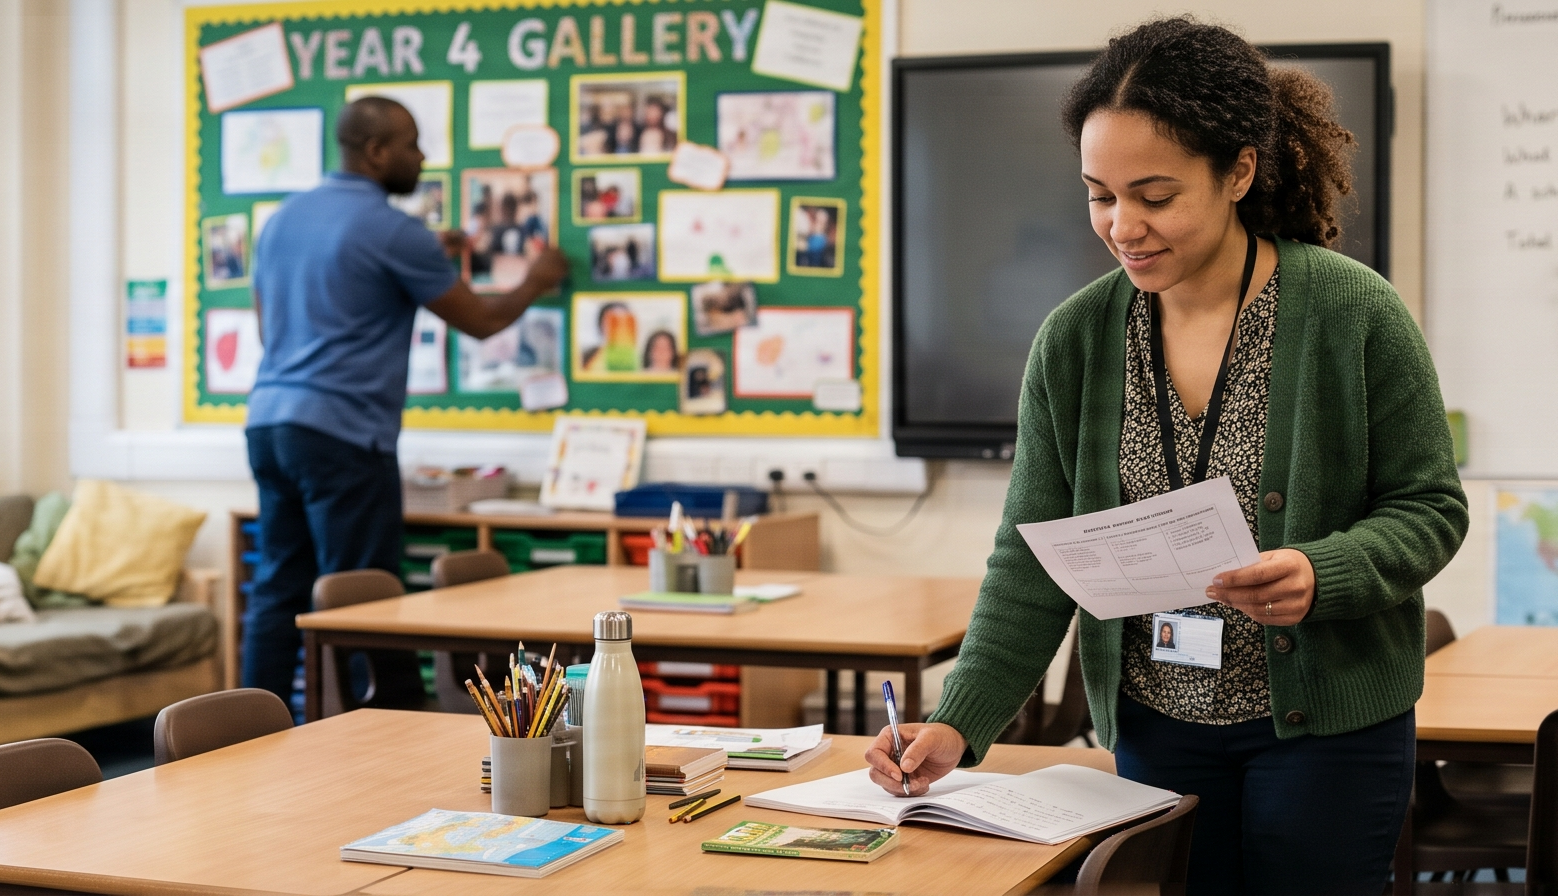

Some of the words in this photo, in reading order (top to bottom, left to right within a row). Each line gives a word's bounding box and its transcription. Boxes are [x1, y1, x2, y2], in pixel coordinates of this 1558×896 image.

[291, 25, 425, 80] YEAR
[446, 21, 483, 73] 4
[508, 10, 758, 71] GALLERY
